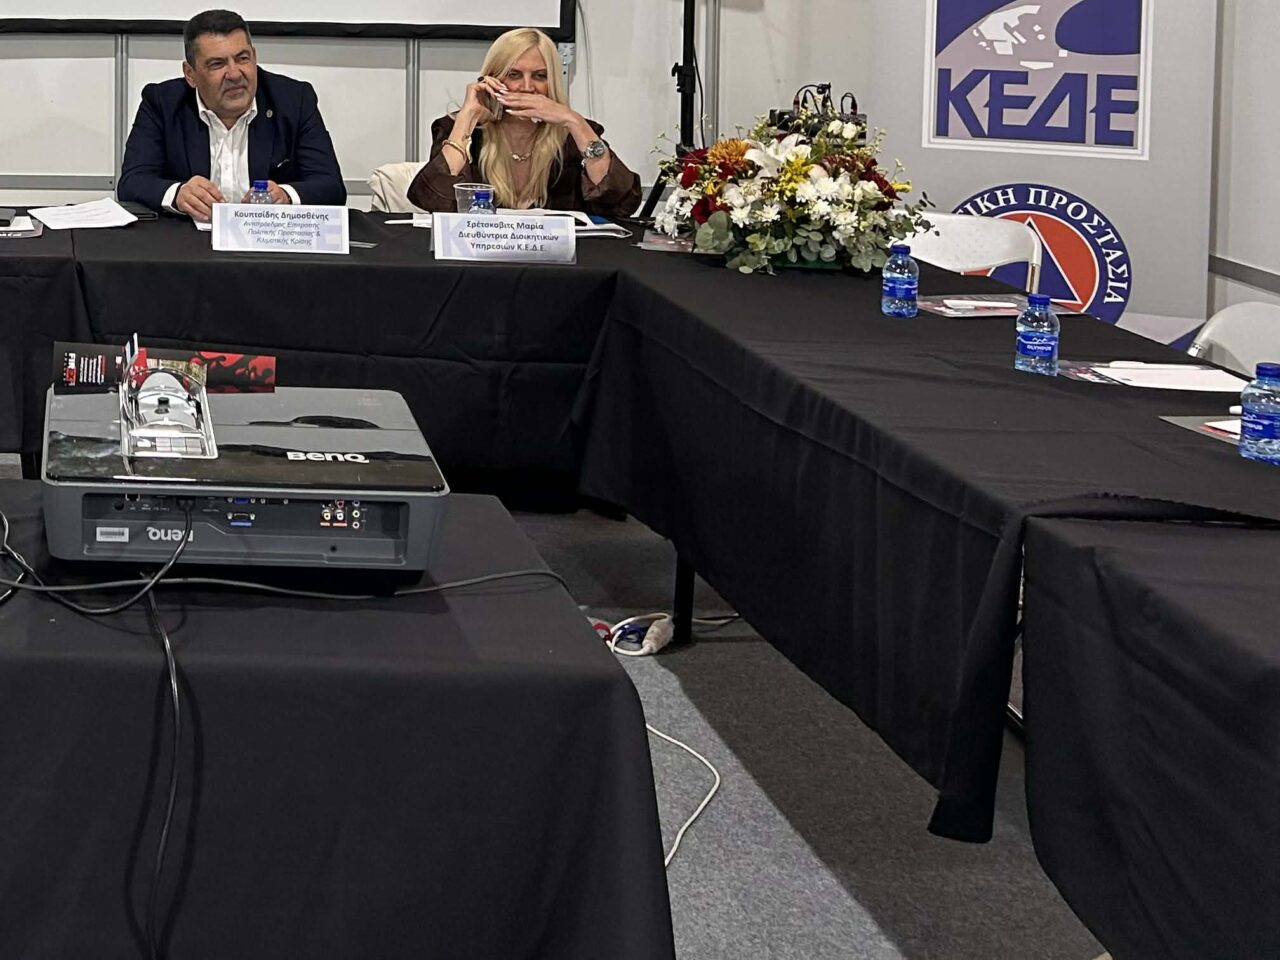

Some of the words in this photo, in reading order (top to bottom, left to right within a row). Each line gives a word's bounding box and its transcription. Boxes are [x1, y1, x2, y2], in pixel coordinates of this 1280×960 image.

[935, 68, 1140, 146] ΚΕΔΕ
[280, 212, 329, 220] Δημοσθένης
[516, 222, 544, 231] Μαρία
[458, 231, 509, 240] Διευθύντρια
[470, 242, 516, 251] Υπηρεσιών
[1026, 187, 1129, 305] ΠΡΟΣΤΑΣΙΑ
[286, 451, 370, 464] BenQ
